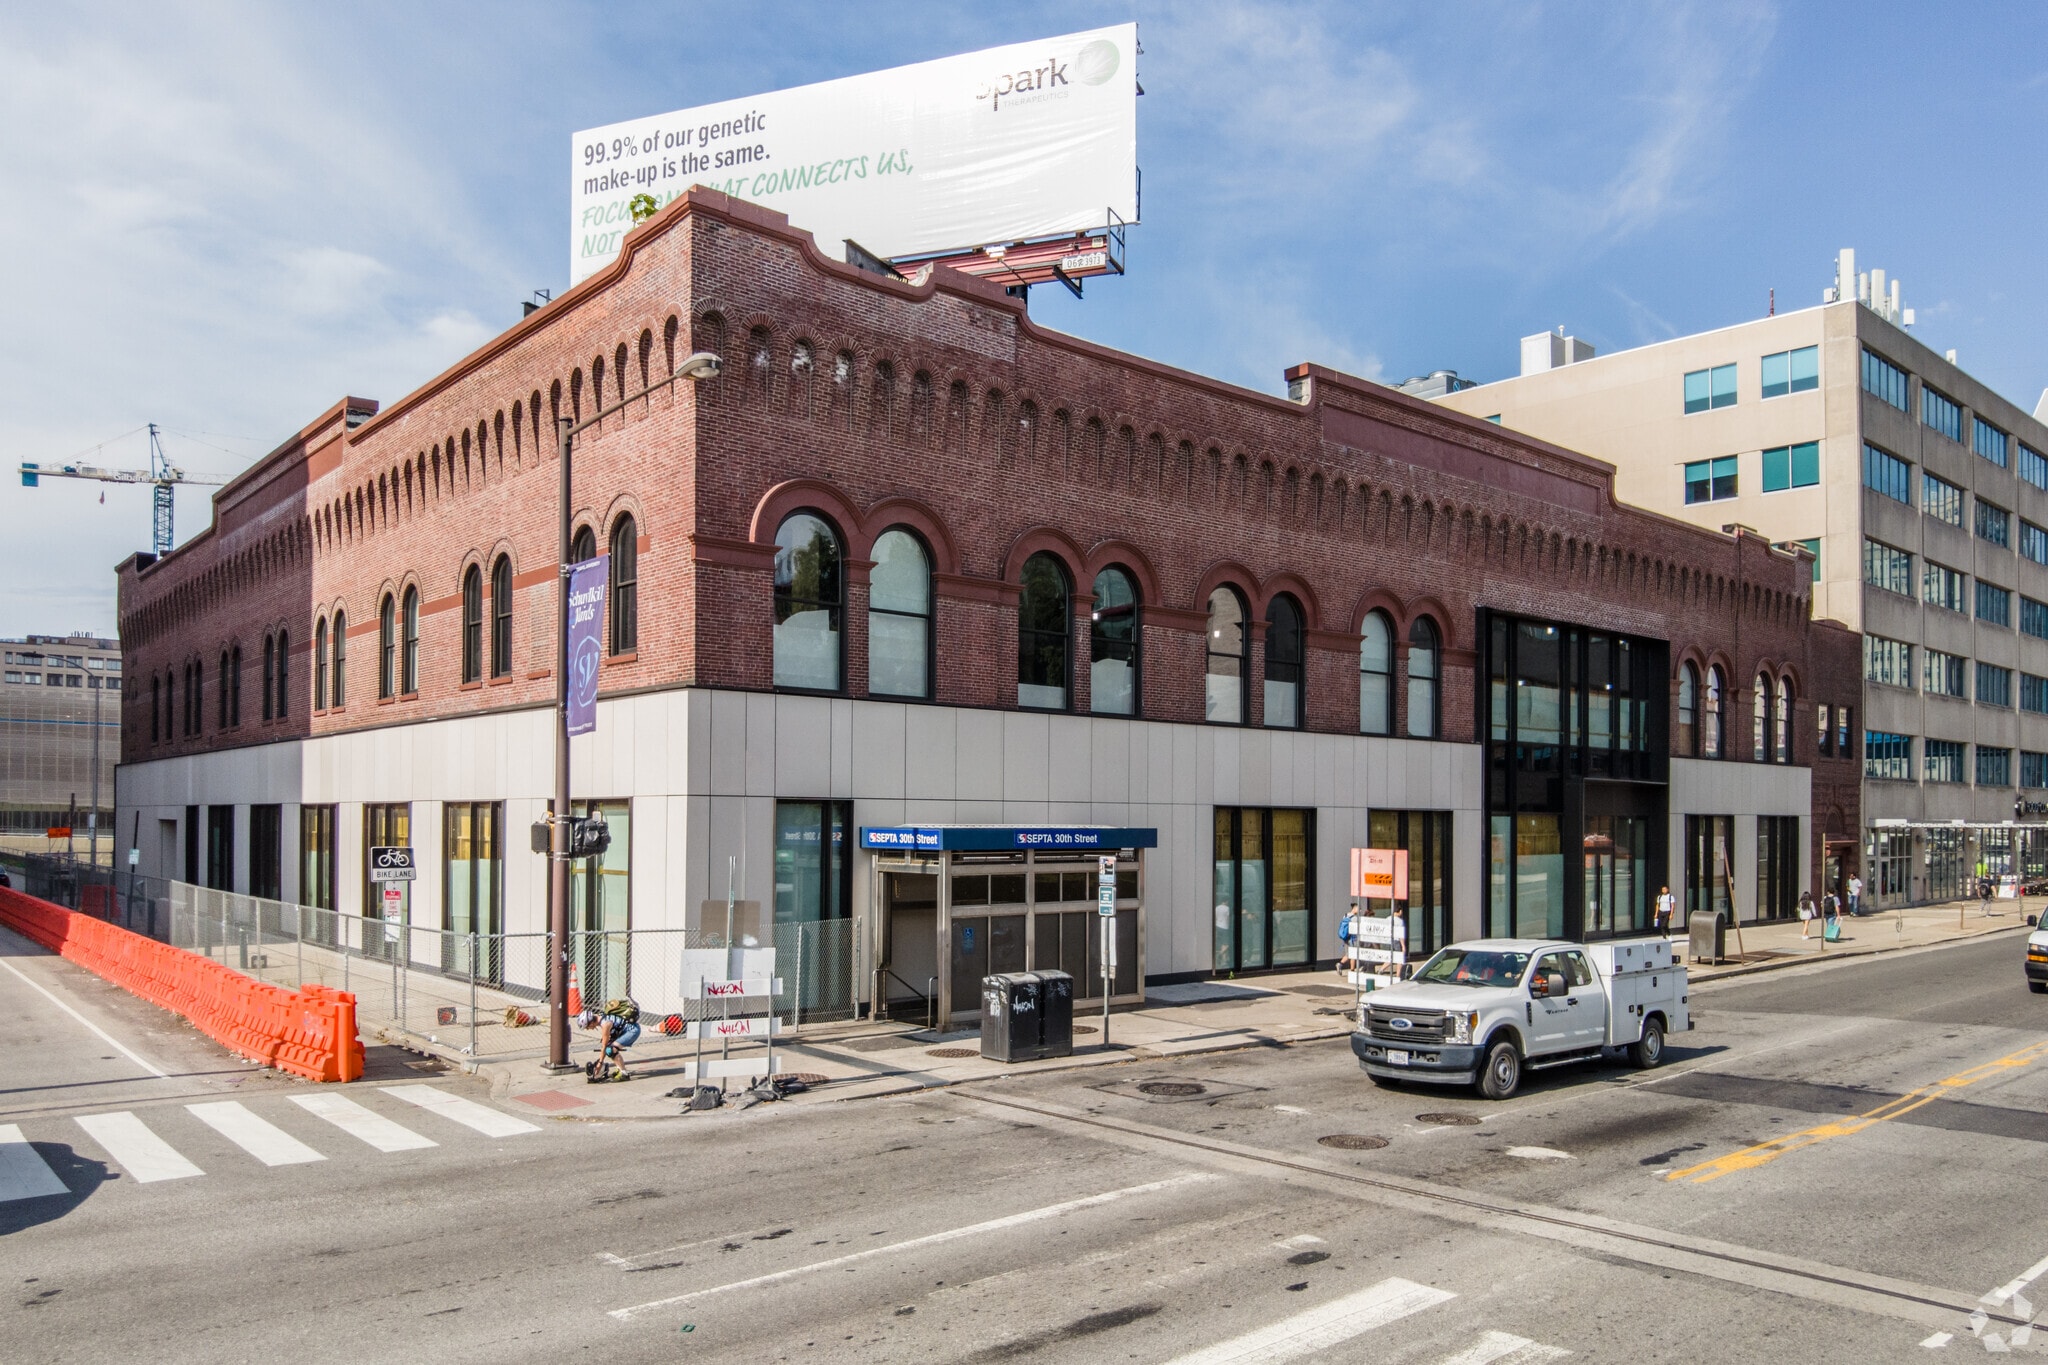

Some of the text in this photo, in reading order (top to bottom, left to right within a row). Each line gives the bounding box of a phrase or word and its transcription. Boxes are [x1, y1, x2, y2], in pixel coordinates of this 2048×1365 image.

[1003, 90, 1069, 108] THERAPEUTICS
[584, 110, 766, 166] 99.9% of our genetic
[584, 144, 770, 195] make-up is the same.
[582, 200, 631, 228] FOCU
[751, 155, 869, 197] CONNECTS
[876, 148, 914, 176] US,
[581, 230, 622, 258] NOT
[877, 833, 938, 845] SEPTA 30th Street
[1027, 834, 1098, 844] SEPTA 30th Street
